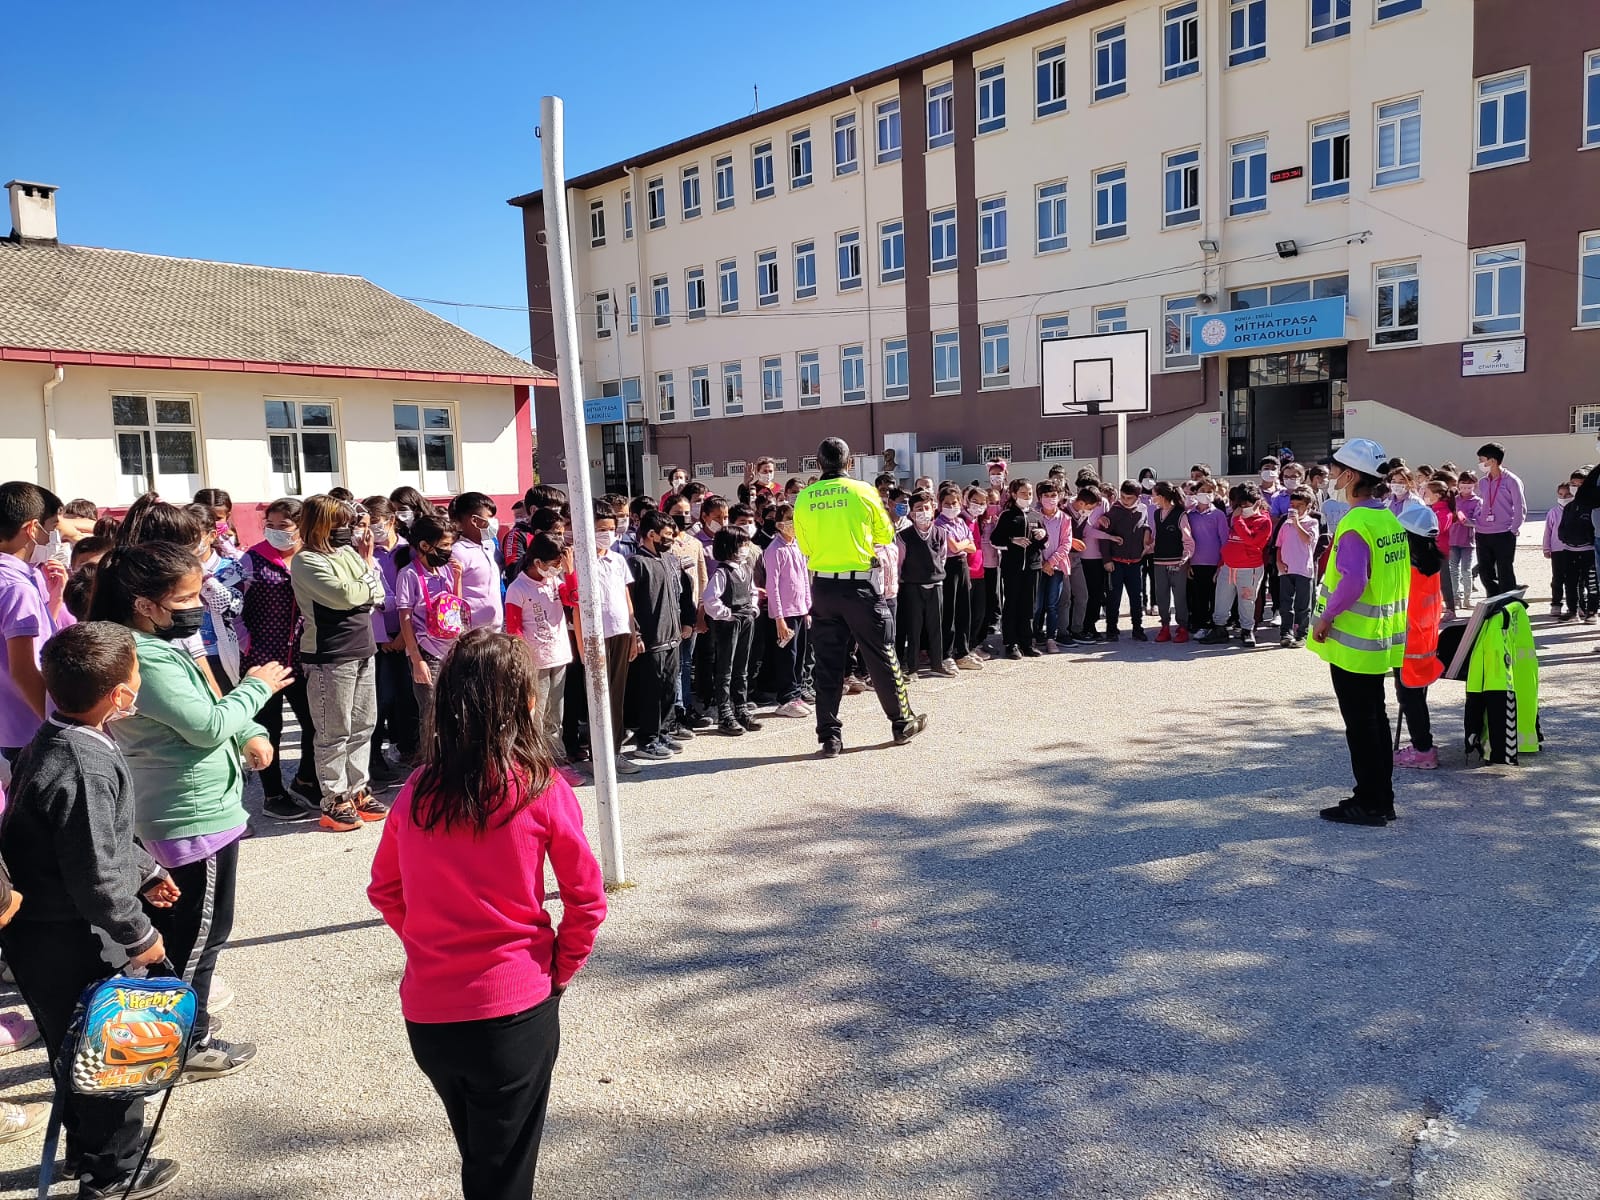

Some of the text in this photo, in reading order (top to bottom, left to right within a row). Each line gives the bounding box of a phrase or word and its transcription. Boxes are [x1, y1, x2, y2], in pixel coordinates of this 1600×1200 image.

[1234, 314, 1318, 333] MİTHATPAŞA
[1234, 326, 1312, 343] ORTAOKULU
[808, 486, 849, 499] TRAFİK
[810, 499, 848, 511] POLİSİ
[128, 991, 170, 1008] Herby
